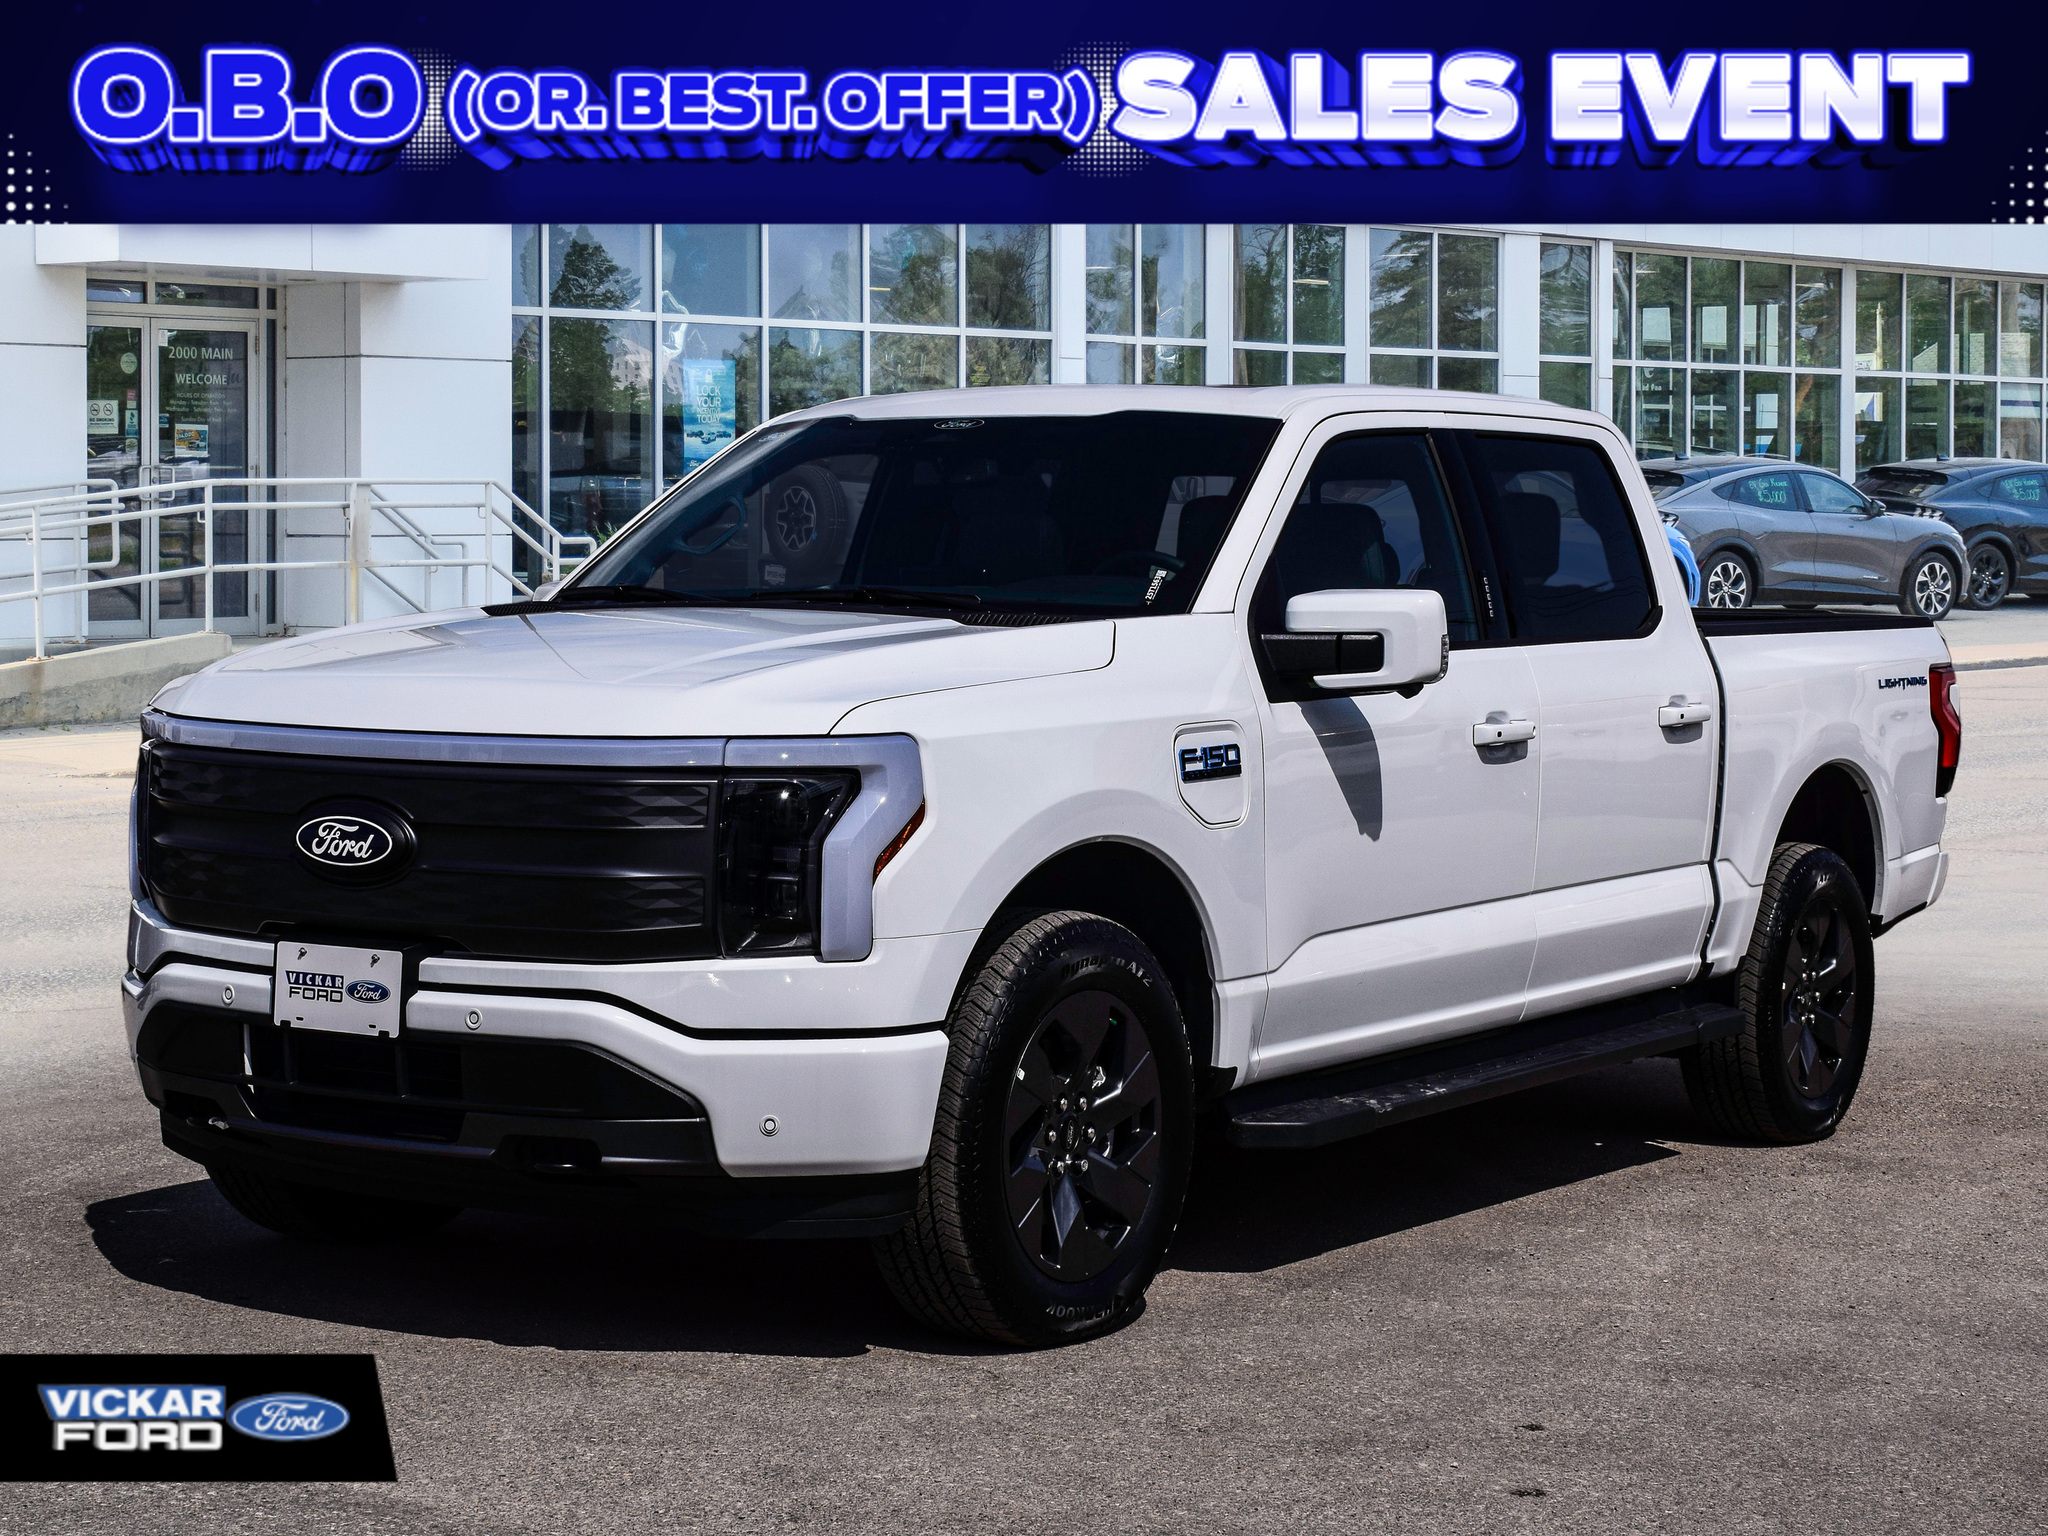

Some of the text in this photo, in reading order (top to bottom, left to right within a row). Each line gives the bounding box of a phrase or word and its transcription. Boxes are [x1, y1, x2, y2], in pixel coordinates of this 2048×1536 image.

[168, 346, 233, 360] 2000 MAIN
[175, 373, 228, 385] WELCOME
[697, 385, 721, 396] LOCK
[697, 397, 721, 407] YOUR
[697, 415, 721, 423] TODAY
[1878, 676, 1928, 690] LIGHTNING
[1178, 743, 1242, 772] F-150
[312, 822, 374, 859] Ford
[288, 972, 343, 989] VICKAR
[289, 986, 343, 1003] FORD
[353, 982, 382, 1001] Ford
